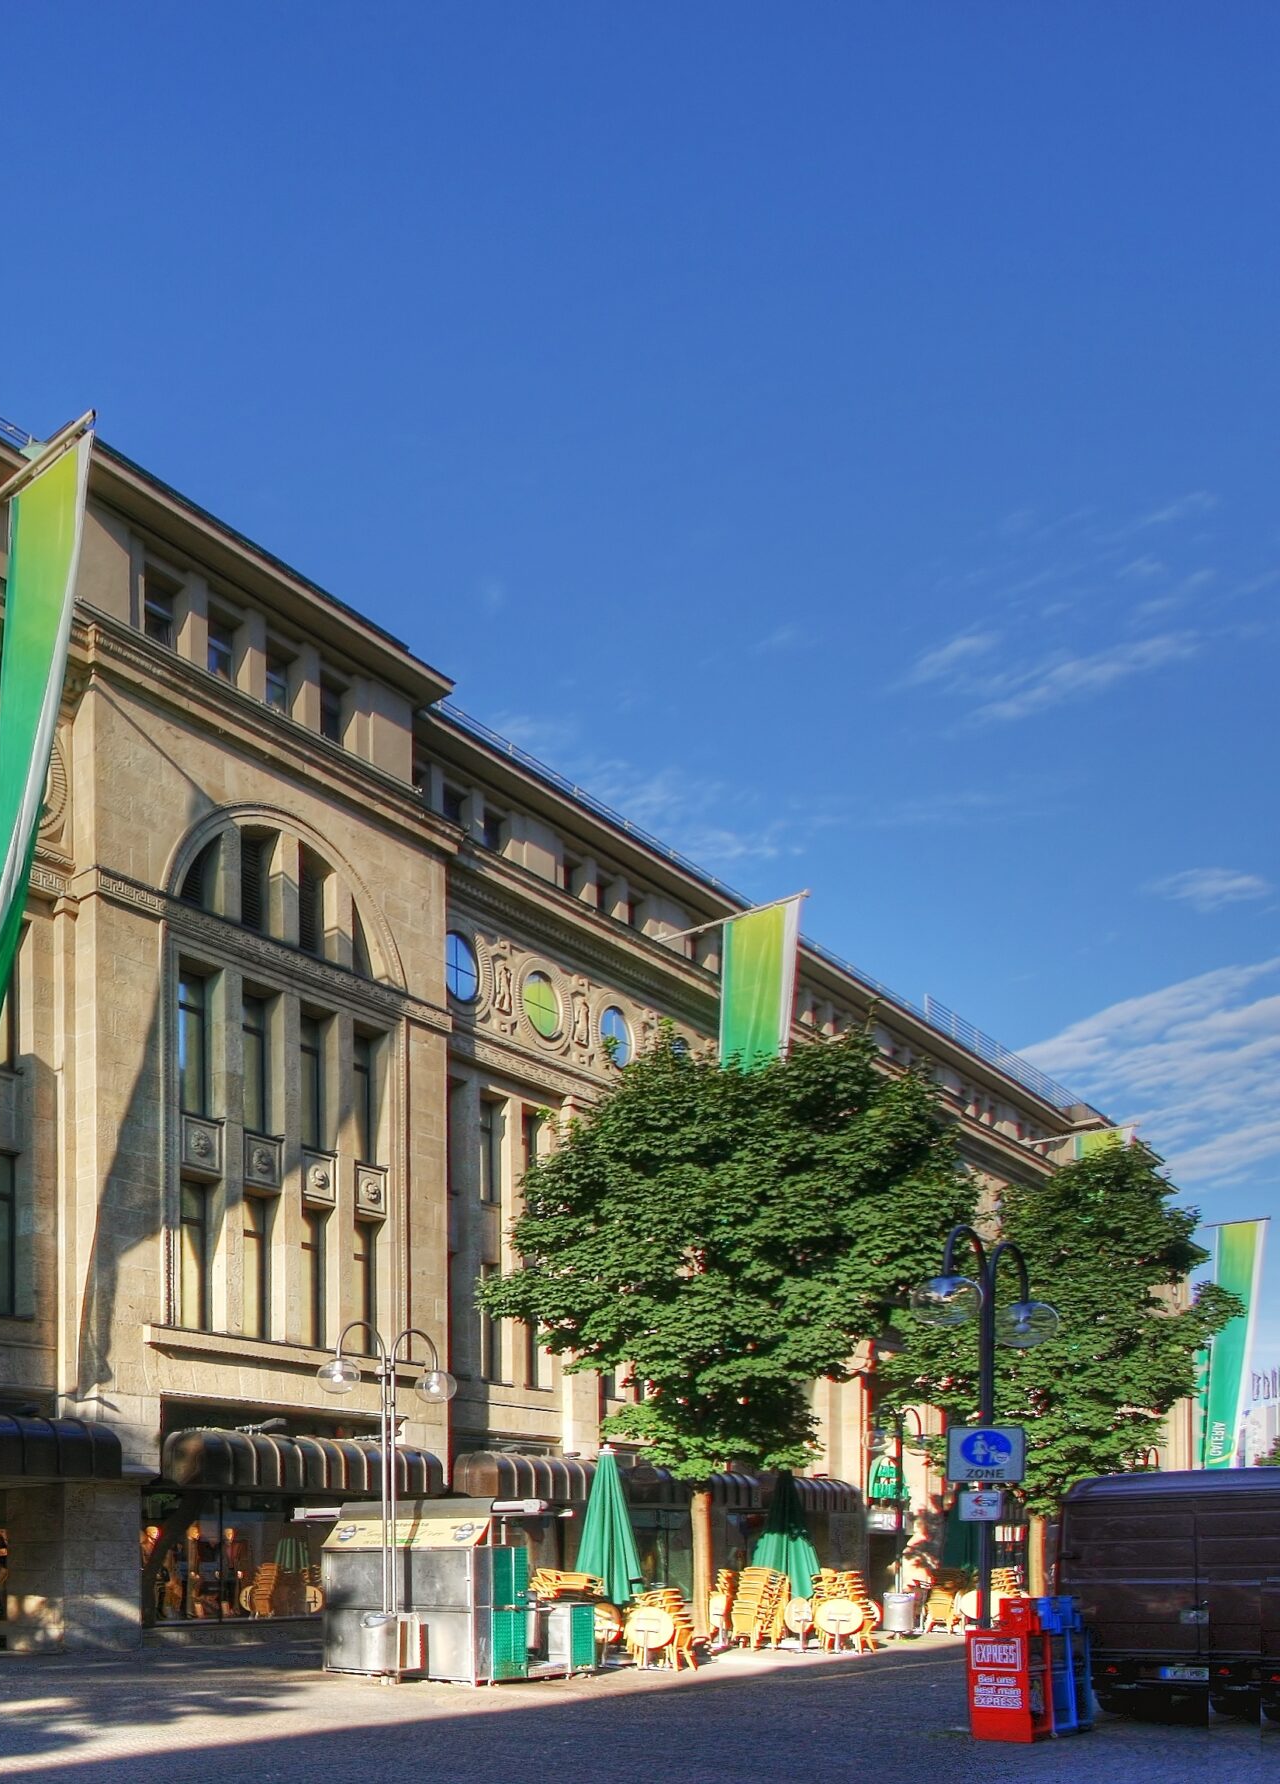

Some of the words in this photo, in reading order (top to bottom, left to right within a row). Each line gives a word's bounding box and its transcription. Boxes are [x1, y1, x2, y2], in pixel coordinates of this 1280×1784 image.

[965, 1468, 1005, 1479] ZONE
[975, 1644, 1017, 1664] EXPRESS
[974, 1696, 1023, 1708] EXPRESS
